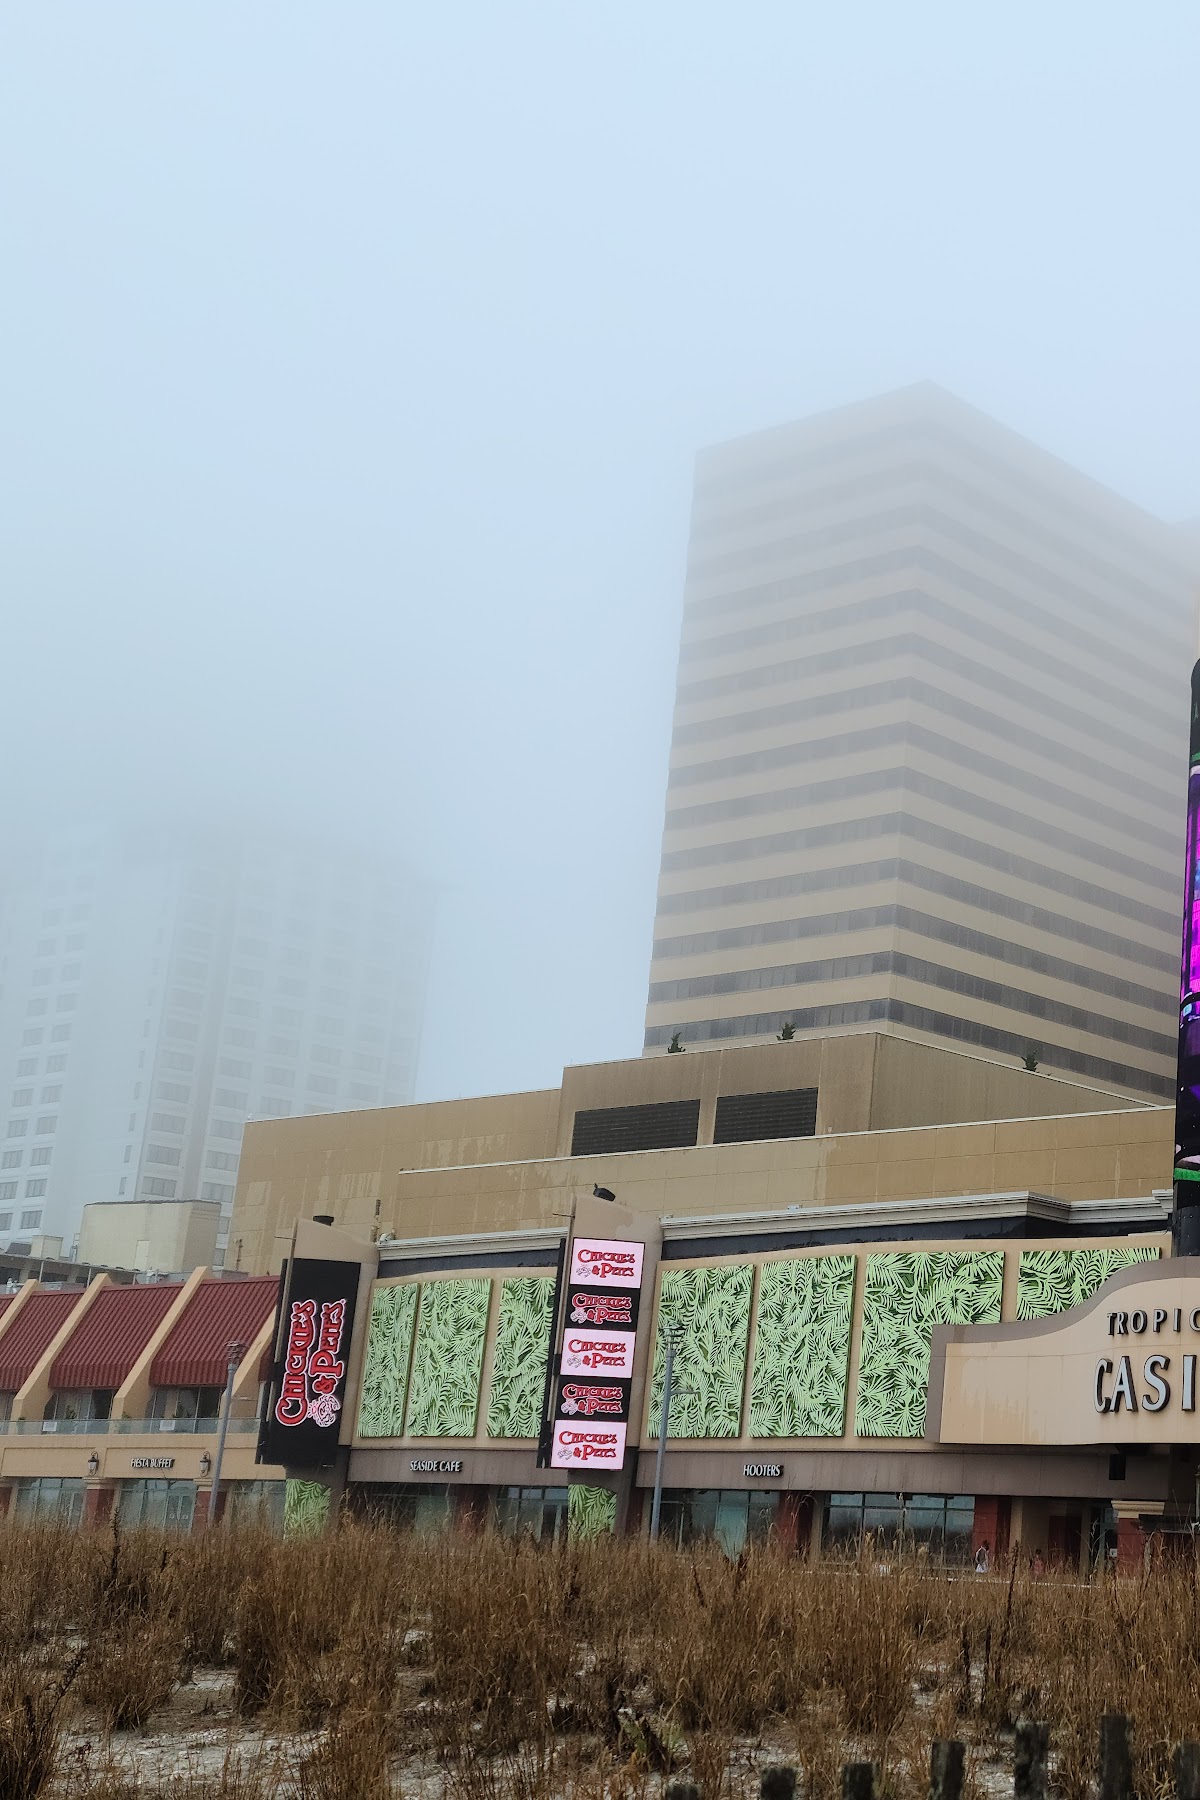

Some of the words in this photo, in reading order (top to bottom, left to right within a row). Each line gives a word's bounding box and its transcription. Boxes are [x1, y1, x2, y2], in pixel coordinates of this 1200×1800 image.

[578, 1249, 636, 1263] CHICKIE'S
[600, 1262, 635, 1278] PETE'S
[572, 1293, 632, 1309] CHICKIE'S
[594, 1307, 632, 1324] PETE'S
[308, 1299, 346, 1378] PETE'S
[568, 1339, 627, 1353] CHICKIE'S
[275, 1299, 316, 1426] CHICKIE'S
[591, 1353, 626, 1368] PETE'S
[312, 1374, 338, 1394] &
[562, 1384, 623, 1399] CHICKIE'S
[585, 1397, 623, 1415] PETE'S
[559, 1431, 618, 1445] CHICKIE'S
[581, 1445, 617, 1460] PETE'S
[150, 1458, 174, 1468] BUFFET
[410, 1460, 438, 1471] SEASIDE
[439, 1460, 461, 1472] CAFE
[743, 1464, 781, 1477] HOOTERS
